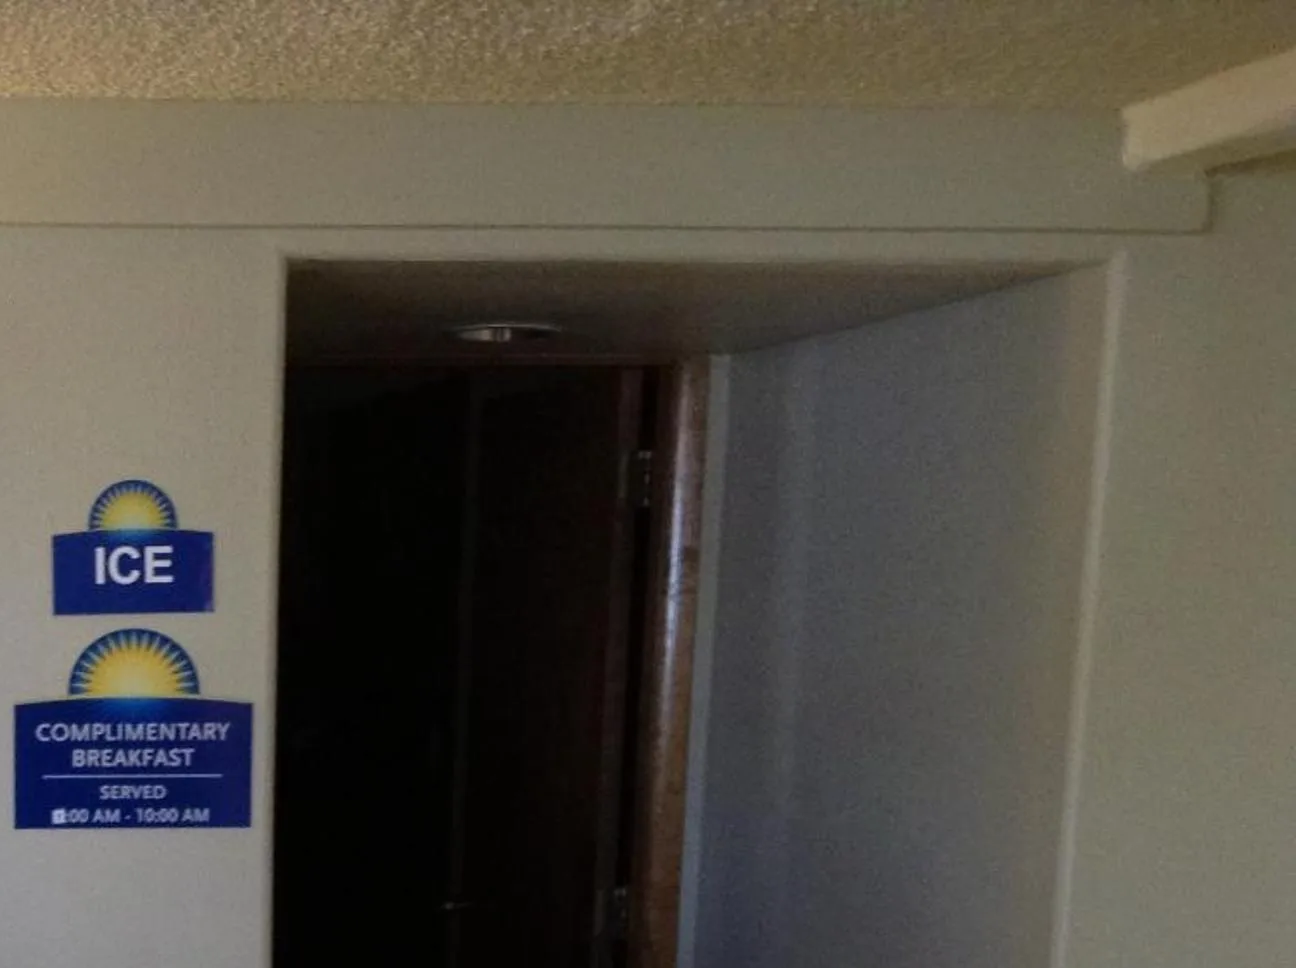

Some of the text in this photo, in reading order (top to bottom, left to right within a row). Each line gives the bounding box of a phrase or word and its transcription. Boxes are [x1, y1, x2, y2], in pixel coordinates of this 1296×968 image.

[94, 545, 175, 585] ICE
[35, 722, 231, 742] COMPLIMENTARY
[71, 748, 196, 768] BREAKFAST
[99, 785, 168, 800] SERVED
[92, 808, 122, 824] AM
[135, 808, 180, 824] 10:00
[181, 807, 211, 823] AM
